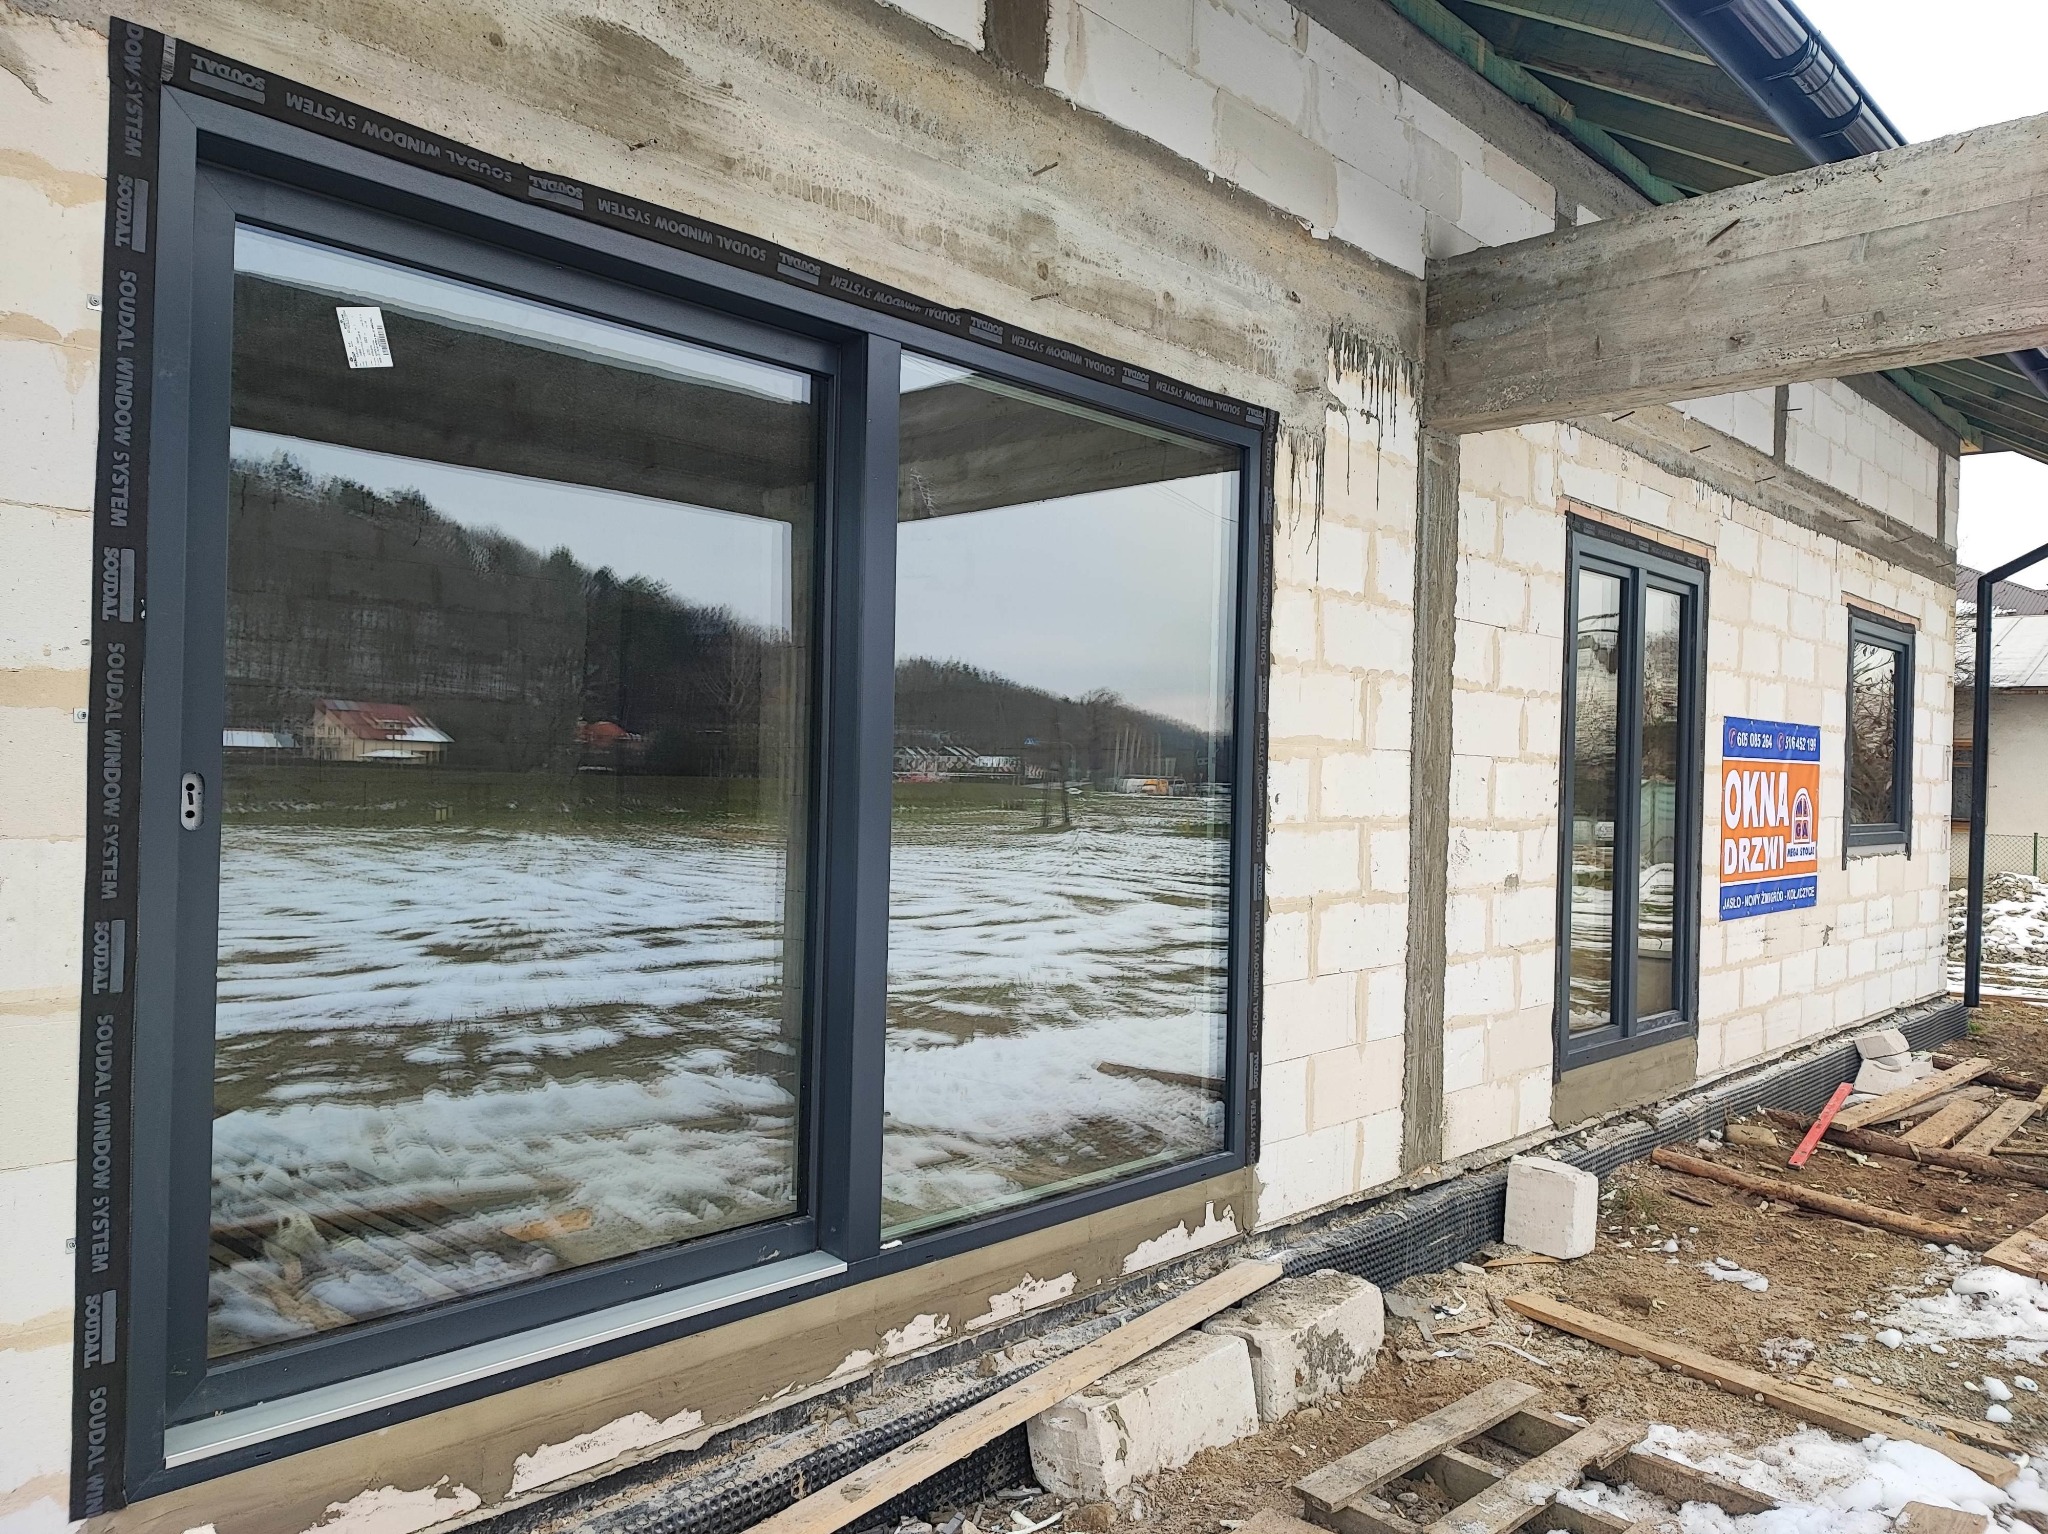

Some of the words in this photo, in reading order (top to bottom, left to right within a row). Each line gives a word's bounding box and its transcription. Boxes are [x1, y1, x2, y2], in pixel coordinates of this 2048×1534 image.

[191, 53, 266, 91] SOUDAL
[125, 80, 144, 158] SYSTEM
[286, 92, 356, 130] SYSTEM
[362, 120, 441, 158] WINDOW
[446, 149, 512, 183] SOUDAL
[528, 175, 583, 199] SOUDAL
[115, 174, 134, 247] SOUDAL
[598, 198, 651, 225] SYSTEM
[655, 215, 713, 245] WINDOW
[716, 235, 767, 262] SOUDAL
[778, 252, 821, 275] SOUDAL
[830, 275, 873, 299] SYSTEM
[117, 270, 137, 351] SOUDAL
[970, 316, 1004, 336] SOUDAL
[1012, 334, 1044, 351] SYSTEM
[1046, 343, 1083, 364] WINDOW
[1084, 357, 1116, 376] SOUDAL
[113, 357, 133, 447] WINDOW
[1156, 381, 1183, 398] SYSTEM
[1183, 391, 1214, 408] WINDOW
[1215, 400, 1241, 416] SOUDAL
[1265, 435, 1273, 477] SOUDAL
[110, 451, 131, 527] SYSTEM
[101, 546, 120, 621] SOUDAL
[105, 642, 126, 724] SOUDAL
[102, 729, 122, 818] WINDOW
[1724, 769, 1790, 830] OKNA
[101, 824, 119, 900] SYSTEM
[1723, 835, 1785, 875] DRZWI
[92, 920, 109, 995] SOUDAL
[94, 1014, 114, 1098] SOUDAL
[1249, 1099, 1257, 1139] SYSTEM
[92, 1101, 112, 1190] WINDOW
[91, 1196, 110, 1273] SYSTEM
[83, 1294, 101, 1369] SOUDAL
[88, 1386, 107, 1472] SOUDAL
